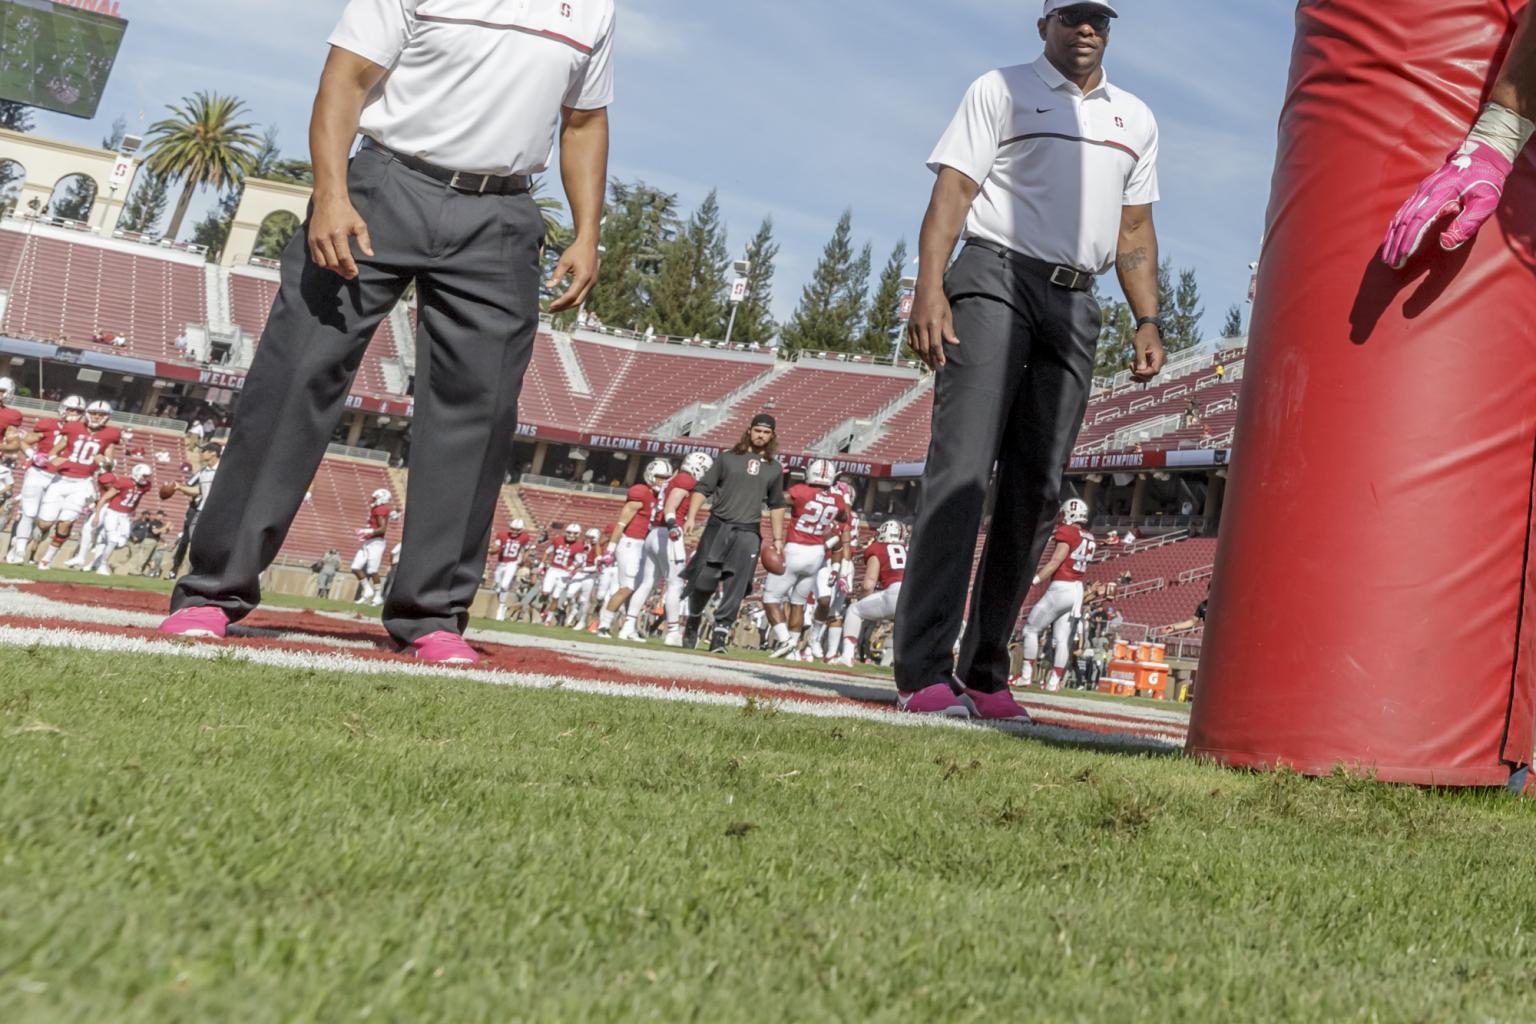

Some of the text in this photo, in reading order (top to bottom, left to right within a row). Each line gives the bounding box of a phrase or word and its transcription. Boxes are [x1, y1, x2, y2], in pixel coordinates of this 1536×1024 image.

[69, 440, 100, 465] 10
[590, 435, 720, 459] WELCOME TO STANFORD
[1070, 453, 1144, 469] HOME OF CHAMPIONS
[1148, 672, 1159, 685] G
